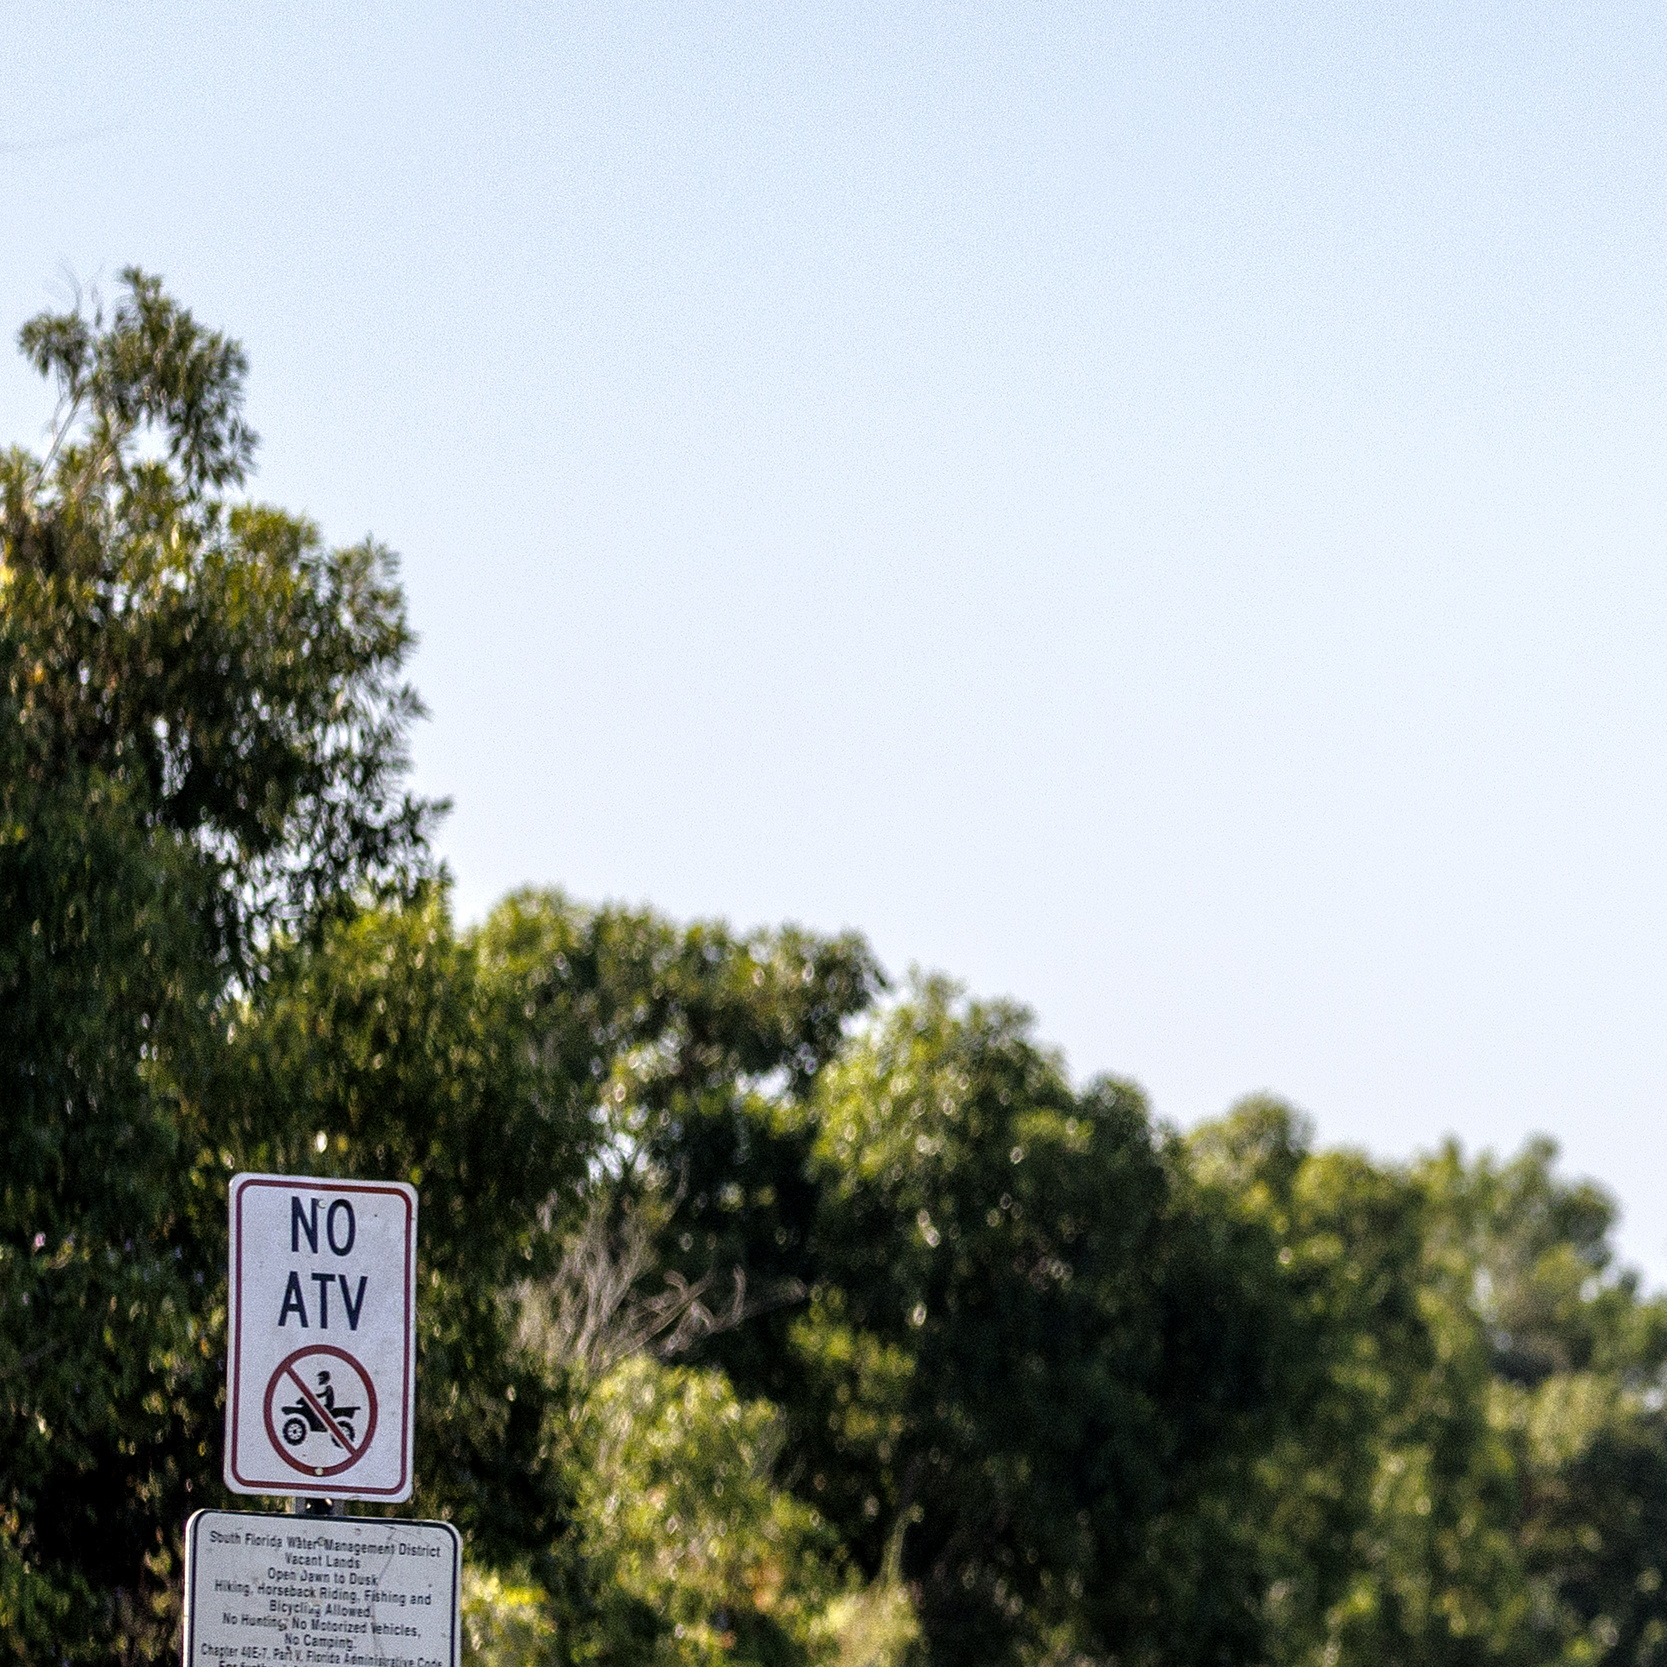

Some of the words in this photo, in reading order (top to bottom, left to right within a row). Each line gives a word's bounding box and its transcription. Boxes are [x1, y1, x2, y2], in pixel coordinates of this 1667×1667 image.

[291, 1196, 356, 1256] NO
[278, 1271, 368, 1331] ATV
[209, 1530, 241, 1545] South
[244, 1532, 283, 1548] Florida
[287, 1536, 317, 1550] Water
[323, 1538, 395, 1556] Management
[398, 1542, 441, 1558] District
[285, 1551, 322, 1567] Vacant
[326, 1554, 360, 1569] Lands
[267, 1567, 297, 1582] Open
[300, 1569, 330, 1583] Dawn
[334, 1572, 345, 1584] to
[215, 1579, 254, 1597] Hiking,
[257, 1581, 316, 1599] Horseback
[319, 1586, 361, 1604] Riding,
[364, 1589, 407, 1607] Fishing
[410, 1593, 432, 1606] and
[269, 1599, 321, 1618] Bicycling
[222, 1612, 238, 1625] No
[292, 1616, 308, 1630] No
[311, 1619, 368, 1634] Motorized
[371, 1622, 422, 1639] Vehicles,
[201, 1643, 239, 1659] Chapter
[274, 1646, 292, 1660] Part
[306, 1650, 340, 1664] Florida
[284, 1633, 300, 1646] No
[303, 1634, 357, 1652] Camping.
